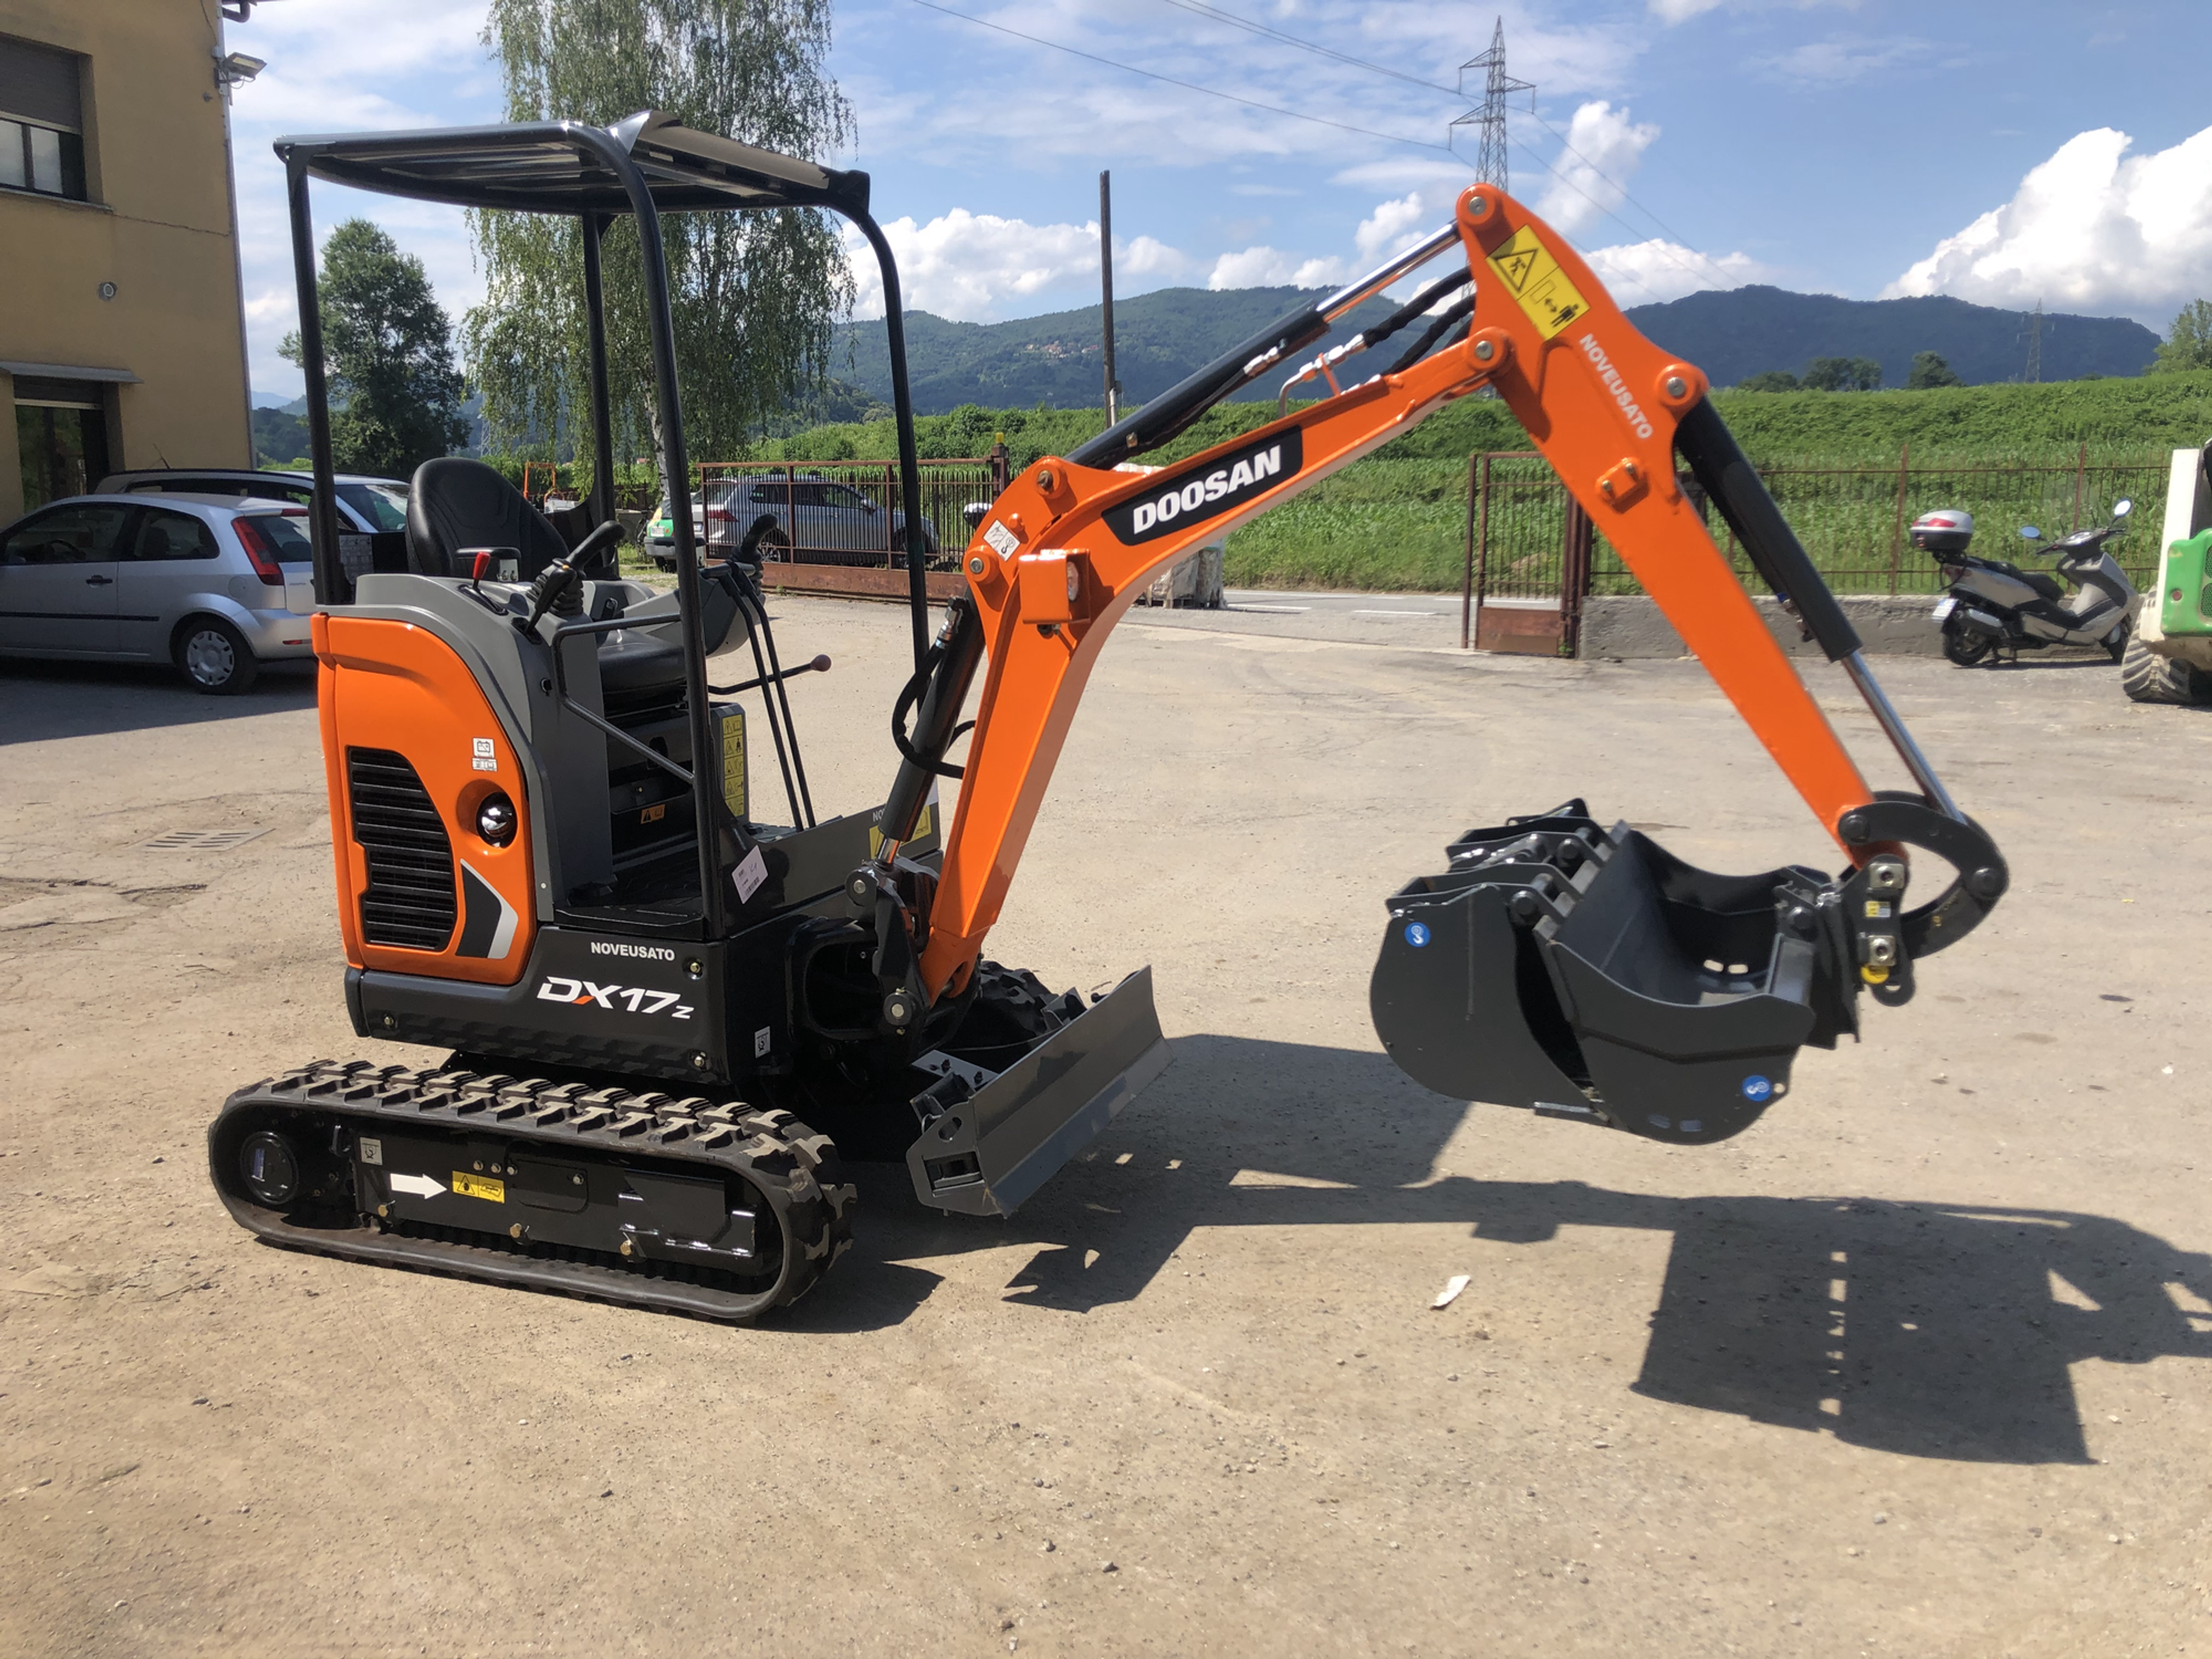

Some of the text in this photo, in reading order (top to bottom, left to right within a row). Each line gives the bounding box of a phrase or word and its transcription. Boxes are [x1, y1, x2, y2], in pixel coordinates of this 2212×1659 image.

[1579, 332, 1654, 439] NOVEUSATO
[1133, 445, 1281, 534] DOOSAN
[590, 942, 675, 961] NOVEUSATO
